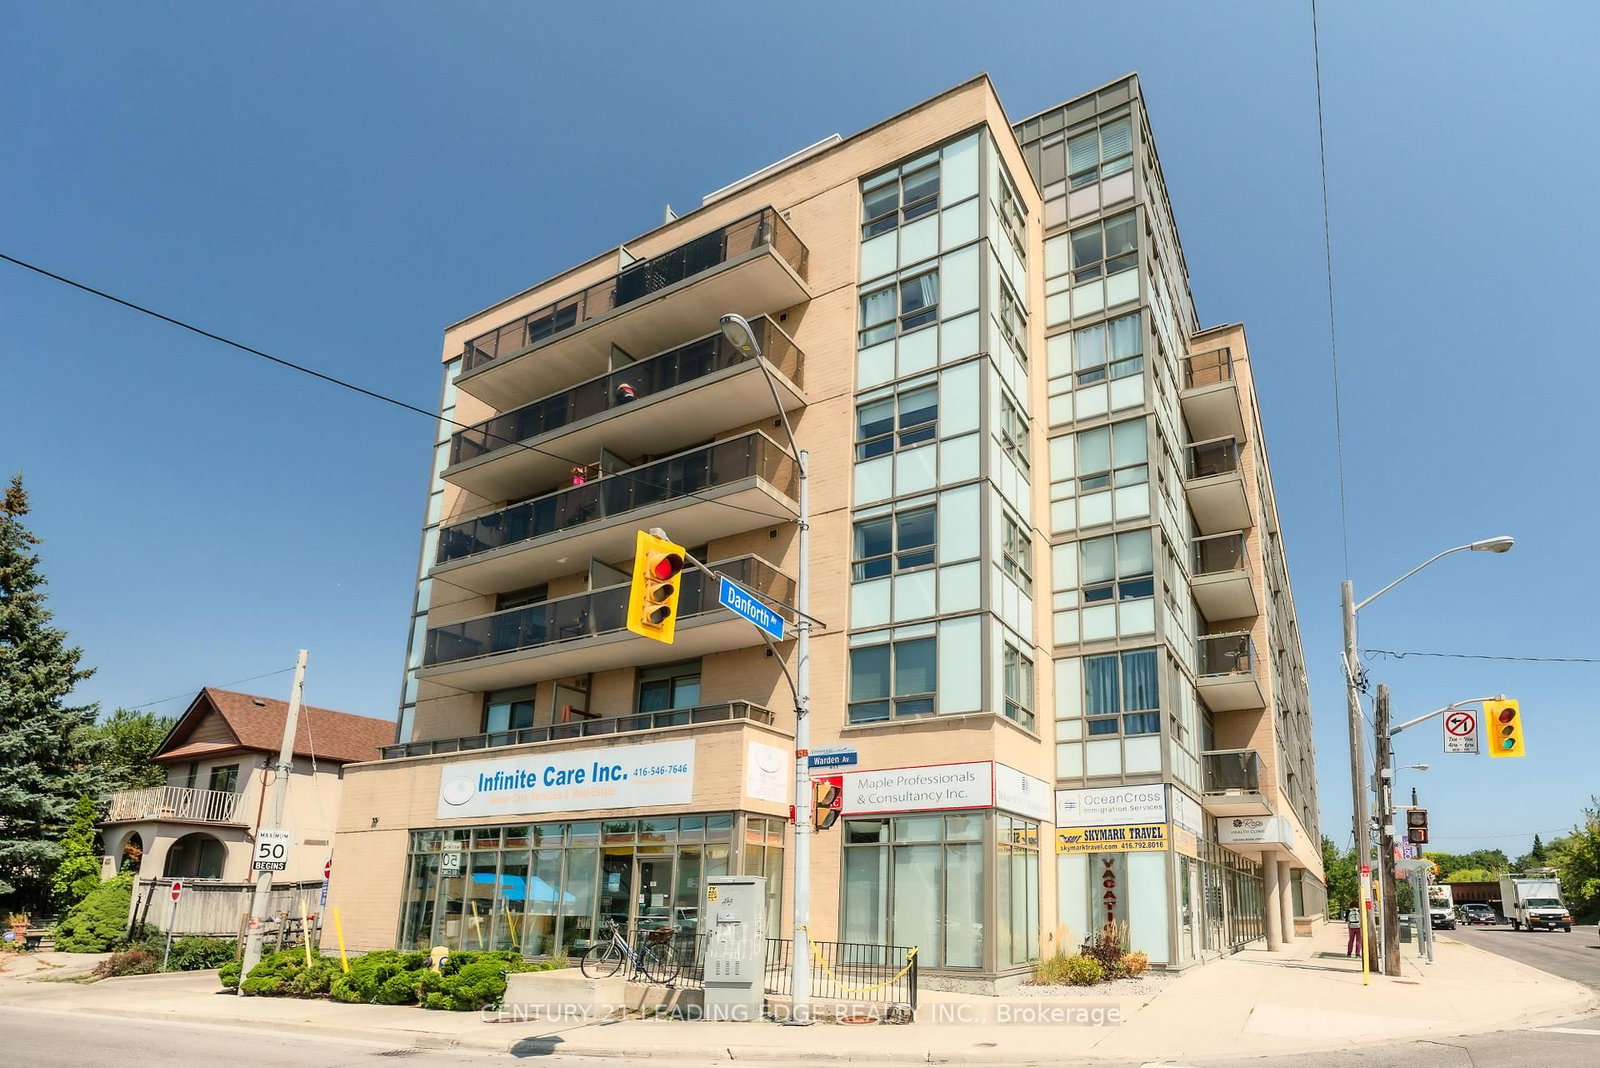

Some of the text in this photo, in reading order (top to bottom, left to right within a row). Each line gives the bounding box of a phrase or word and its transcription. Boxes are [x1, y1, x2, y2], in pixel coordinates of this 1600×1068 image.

[728, 586, 777, 627] Danforth Av
[813, 756, 840, 765] Warden
[478, 769, 537, 792] Infinite
[543, 766, 585, 787] Care
[592, 762, 628, 783] Inc.
[633, 764, 688, 777] 416-546-7646
[857, 771, 975, 790] Maple Professionals
[857, 789, 968, 804] & Consultancy Inc.
[1084, 792, 1161, 806] OceanCross
[1130, 804, 1163, 812] Services
[1243, 818, 1263, 829] Rose
[1084, 828, 1125, 841] SKYMARK
[1129, 827, 1163, 839] TRAVEL
[258, 843, 285, 859] 50
[1060, 841, 1164, 853] skymarktravel.com 416.792.8016
[255, 862, 284, 870] BEGINS
